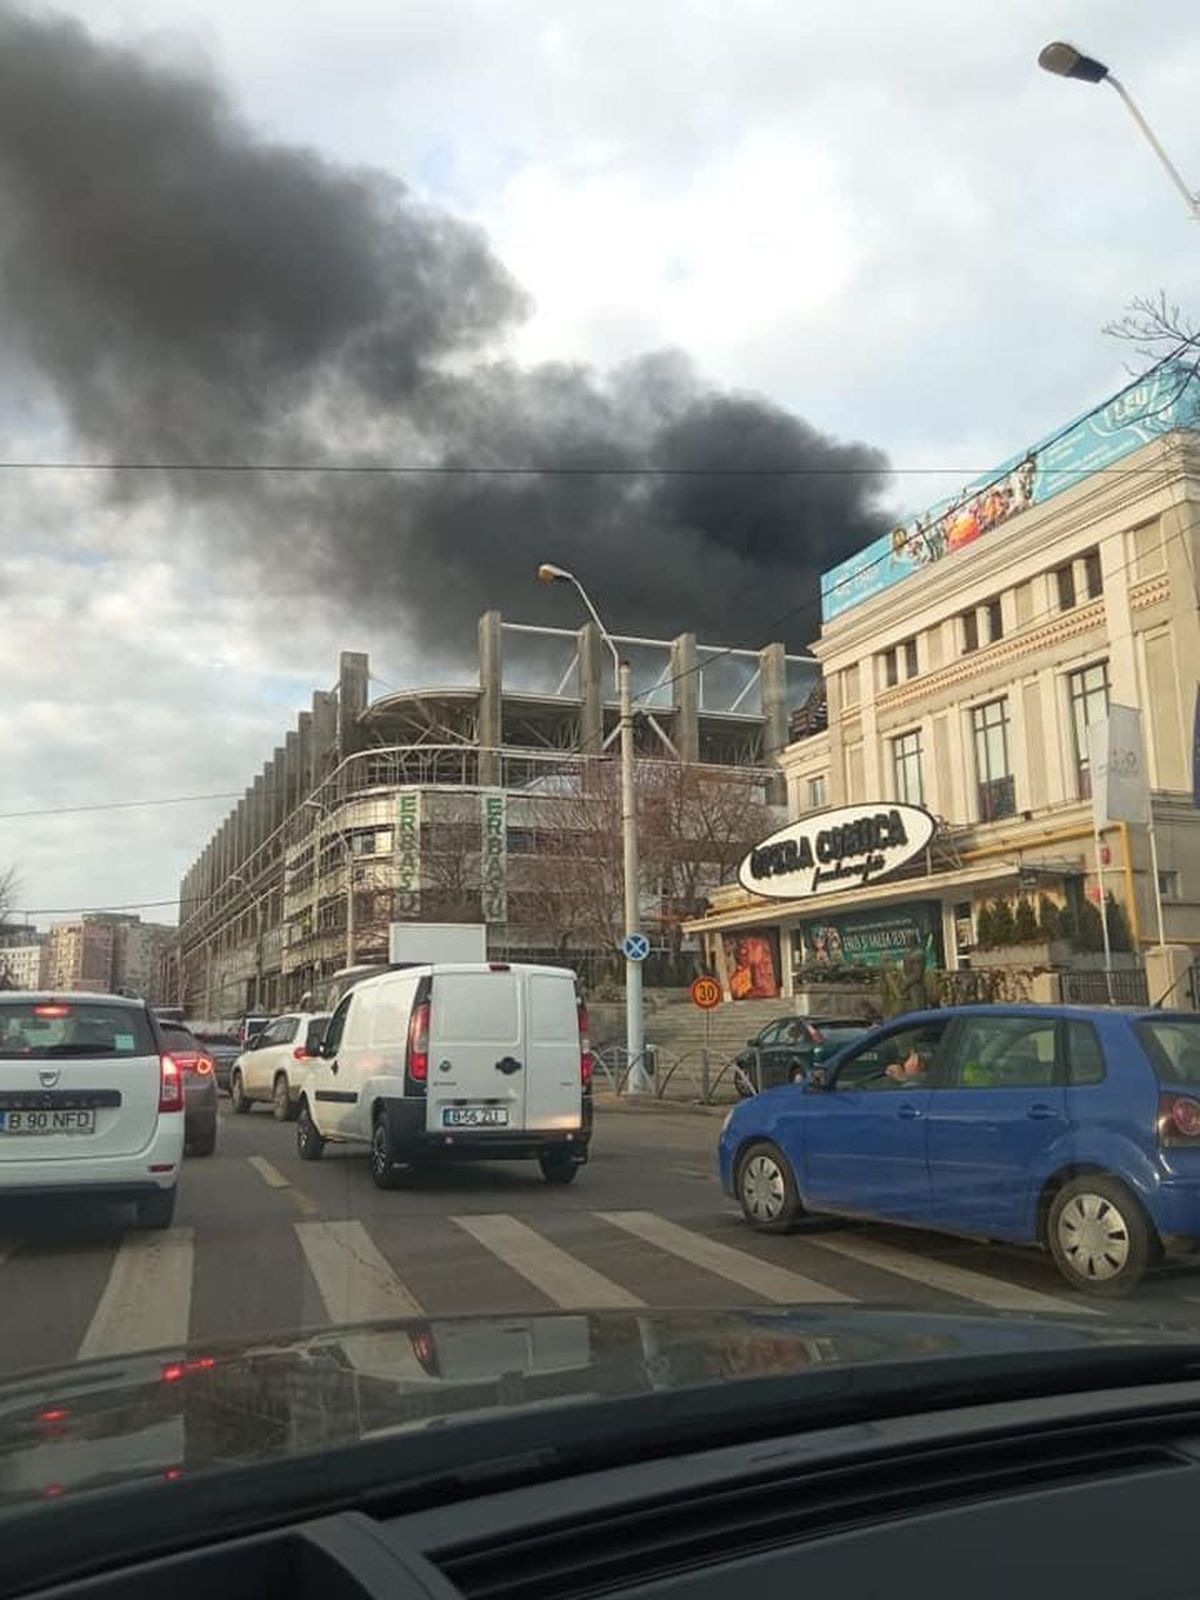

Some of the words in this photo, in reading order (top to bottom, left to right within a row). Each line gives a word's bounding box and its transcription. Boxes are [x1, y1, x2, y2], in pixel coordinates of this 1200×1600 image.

[699, 985, 714, 1001] 30
[9, 1112, 21, 1129] B
[27, 1112, 47, 1128] 90
[53, 1111, 90, 1127] NFD
